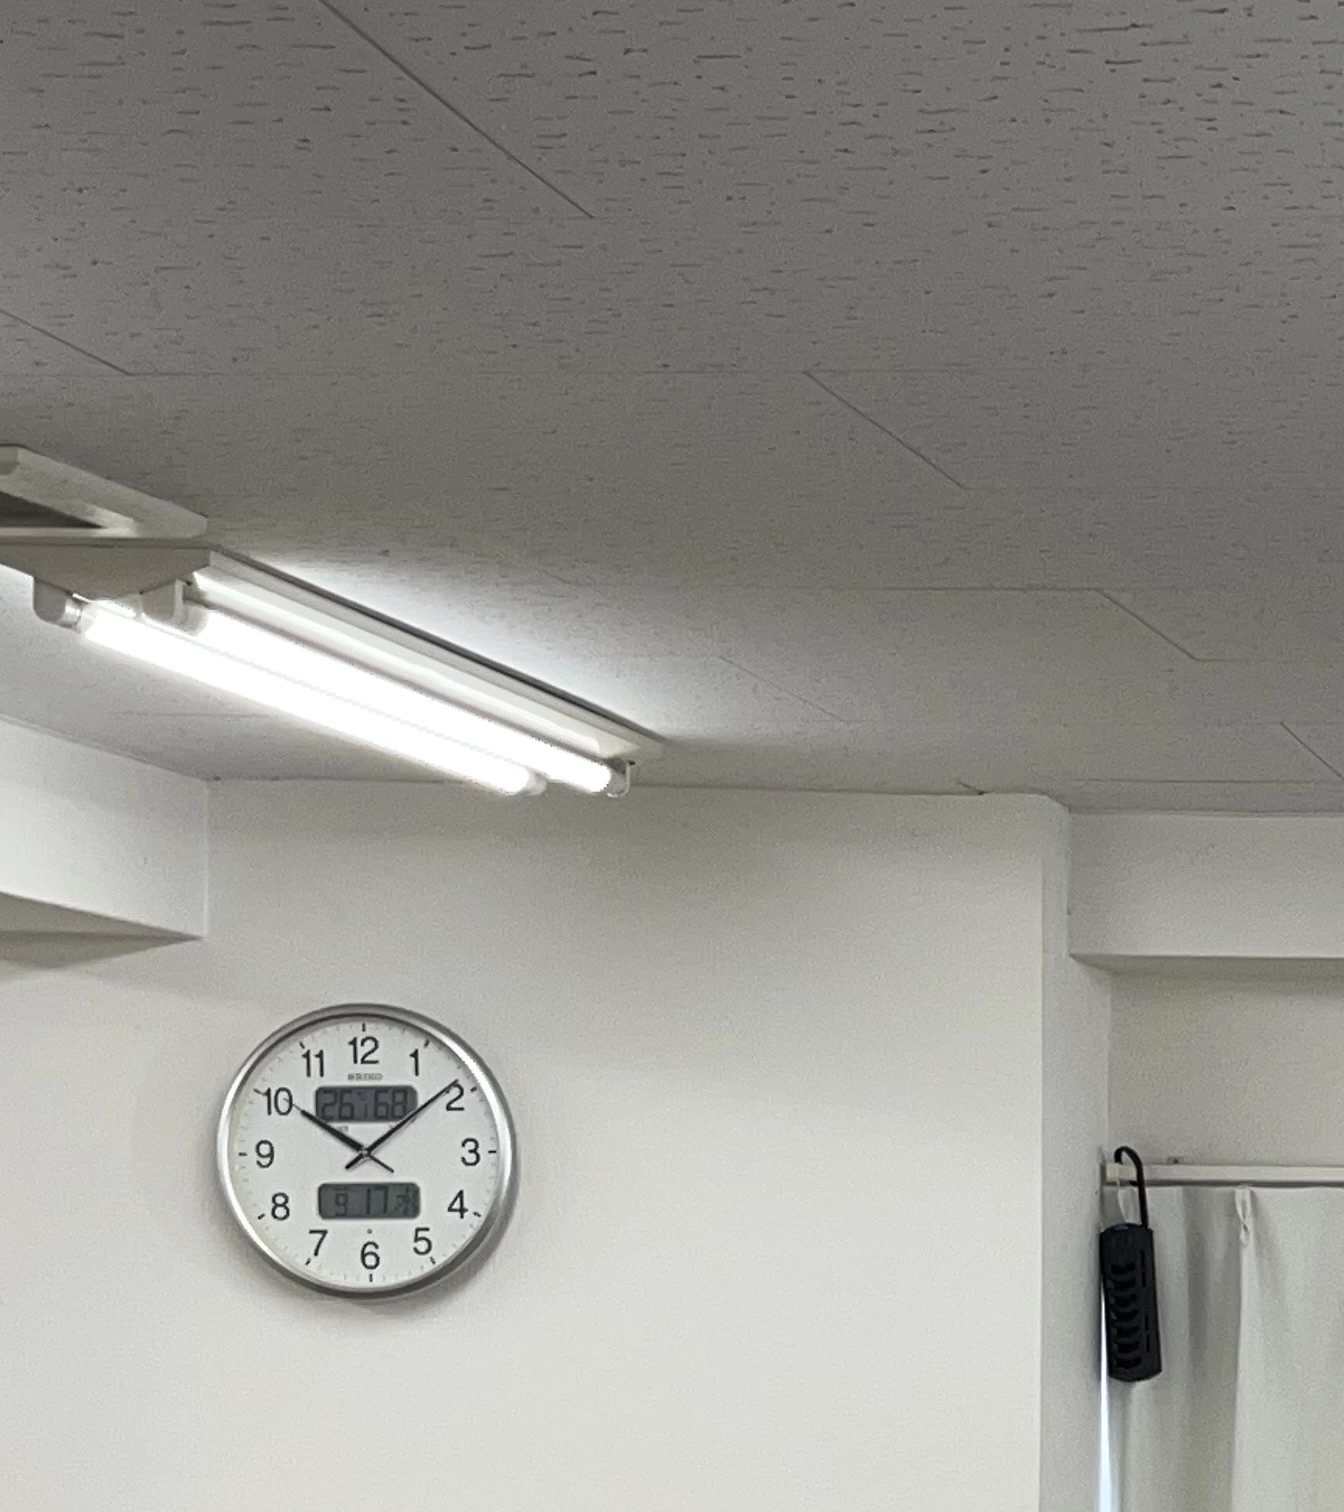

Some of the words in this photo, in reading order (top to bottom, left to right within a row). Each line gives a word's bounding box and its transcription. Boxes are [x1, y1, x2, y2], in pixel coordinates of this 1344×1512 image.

[302, 1050, 324, 1077] 11
[348, 1036, 379, 1064] 12
[410, 1049, 419, 1076] 1
[263, 1086, 294, 1117] 10
[446, 1084, 465, 1112] 2
[256, 1140, 274, 1168] 9
[461, 1138, 480, 1166] 3
[271, 1193, 289, 1220] 8
[448, 1190, 468, 1219] 4
[309, 1230, 328, 1256] 7
[361, 1241, 380, 1269] 6
[414, 1227, 432, 1255] 5
